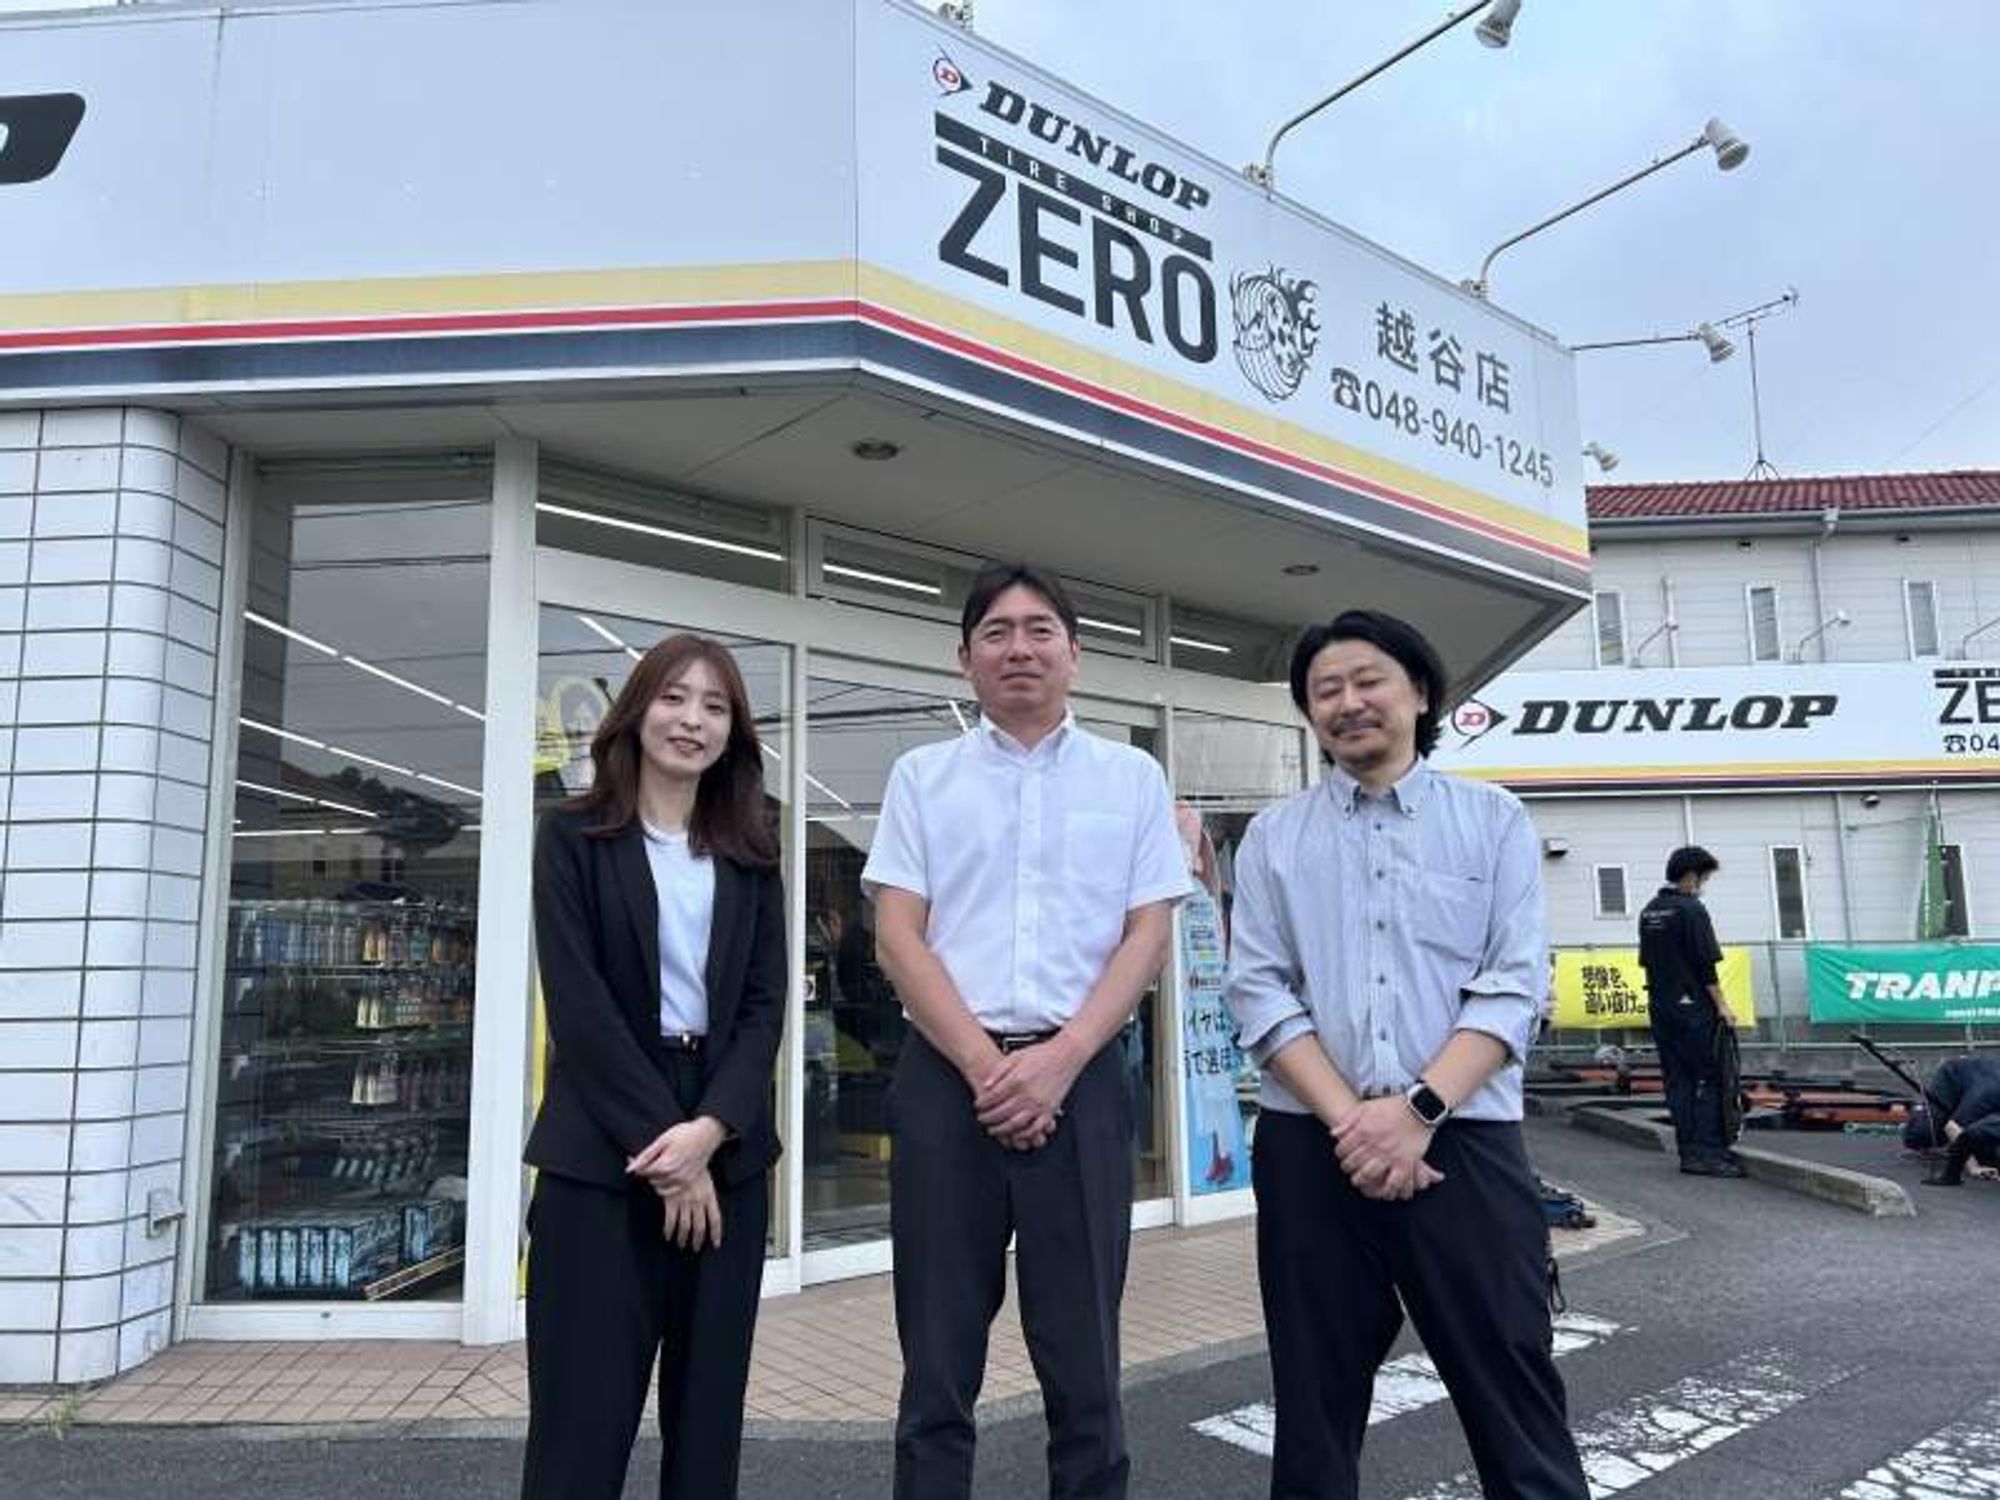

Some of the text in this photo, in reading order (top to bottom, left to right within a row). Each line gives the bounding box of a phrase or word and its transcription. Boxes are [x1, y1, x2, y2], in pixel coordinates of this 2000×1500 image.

[979, 80, 1210, 211] DUNLOP
[979, 136, 1183, 244] TIRE SHOP
[936, 145, 1218, 364] ZERO
[1376, 301, 1511, 414] 越谷店
[1364, 380, 1554, 489] 048-940-1245
[1511, 694, 1839, 736] DUNLOP
